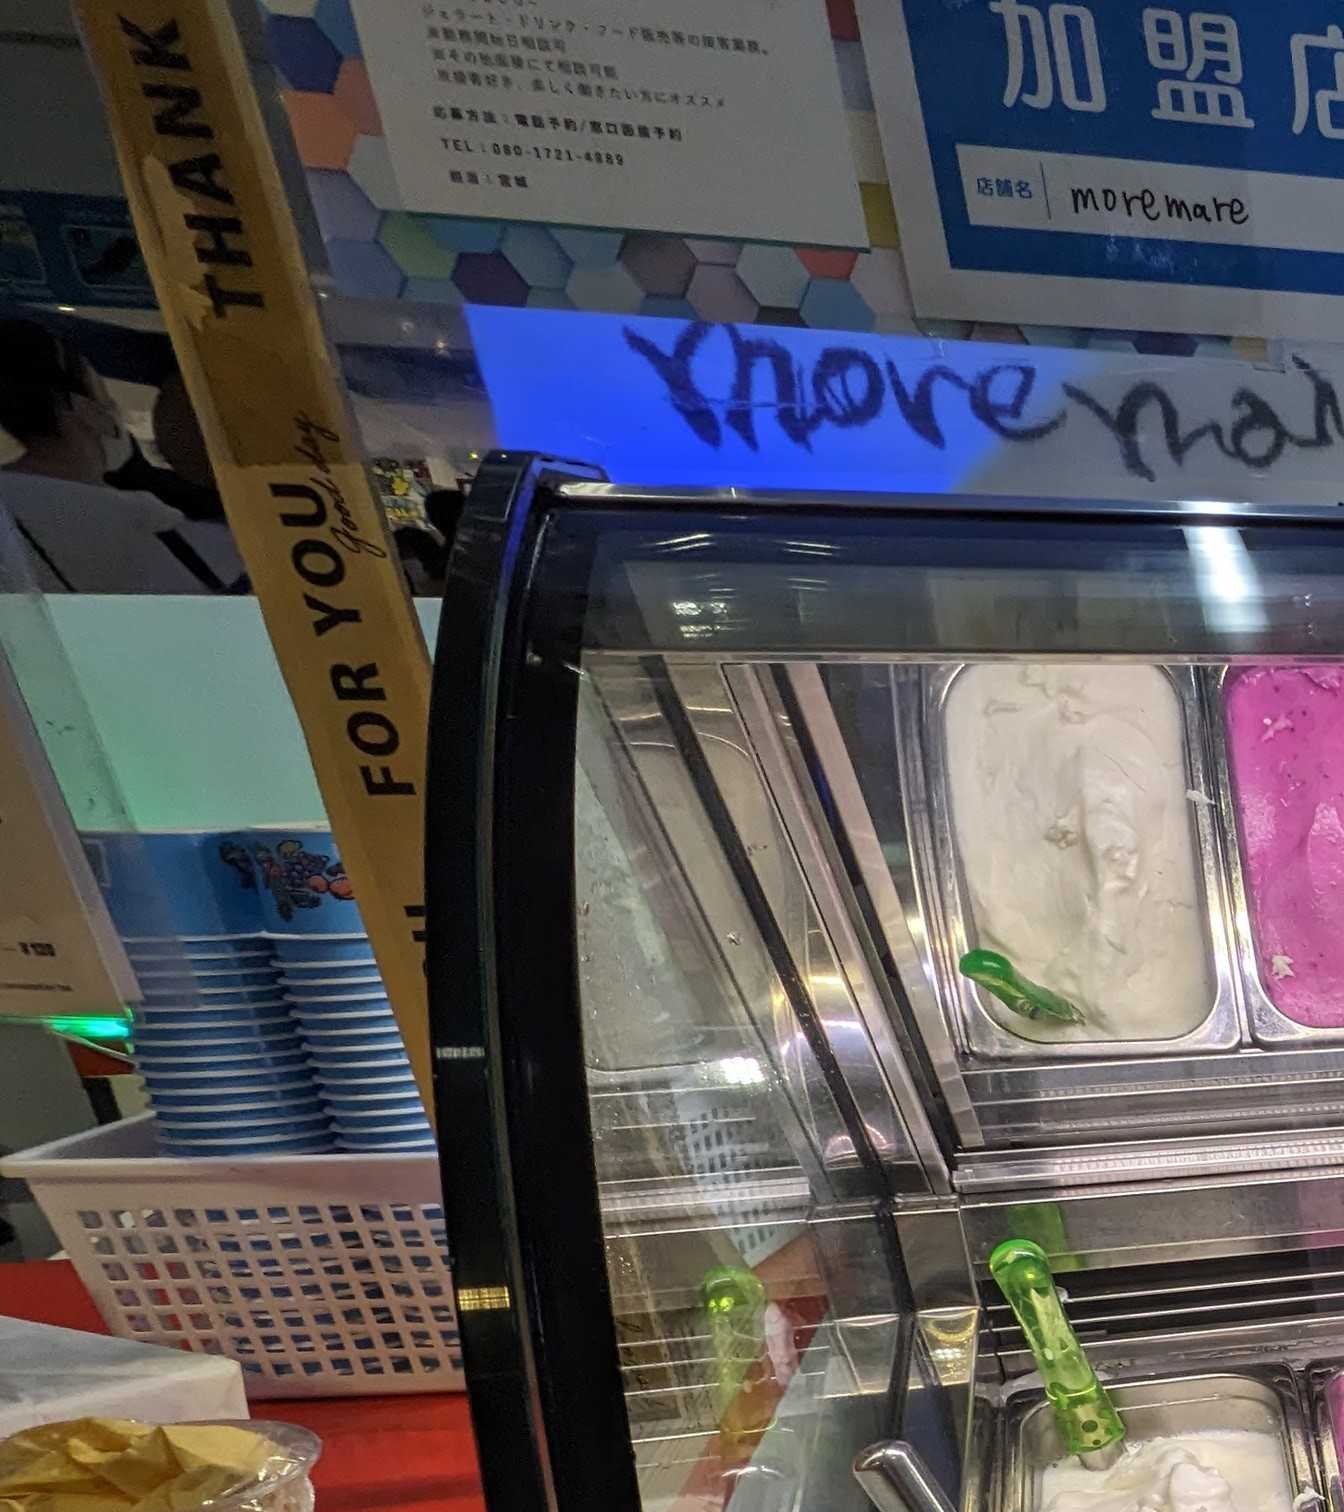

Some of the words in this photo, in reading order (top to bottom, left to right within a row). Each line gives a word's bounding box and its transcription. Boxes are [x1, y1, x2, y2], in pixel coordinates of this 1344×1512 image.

[120, 16, 266, 321] THANK
[976, 175, 1034, 201] 店舗名
[267, 481, 363, 638] YOU
[330, 661, 418, 799] FOR
